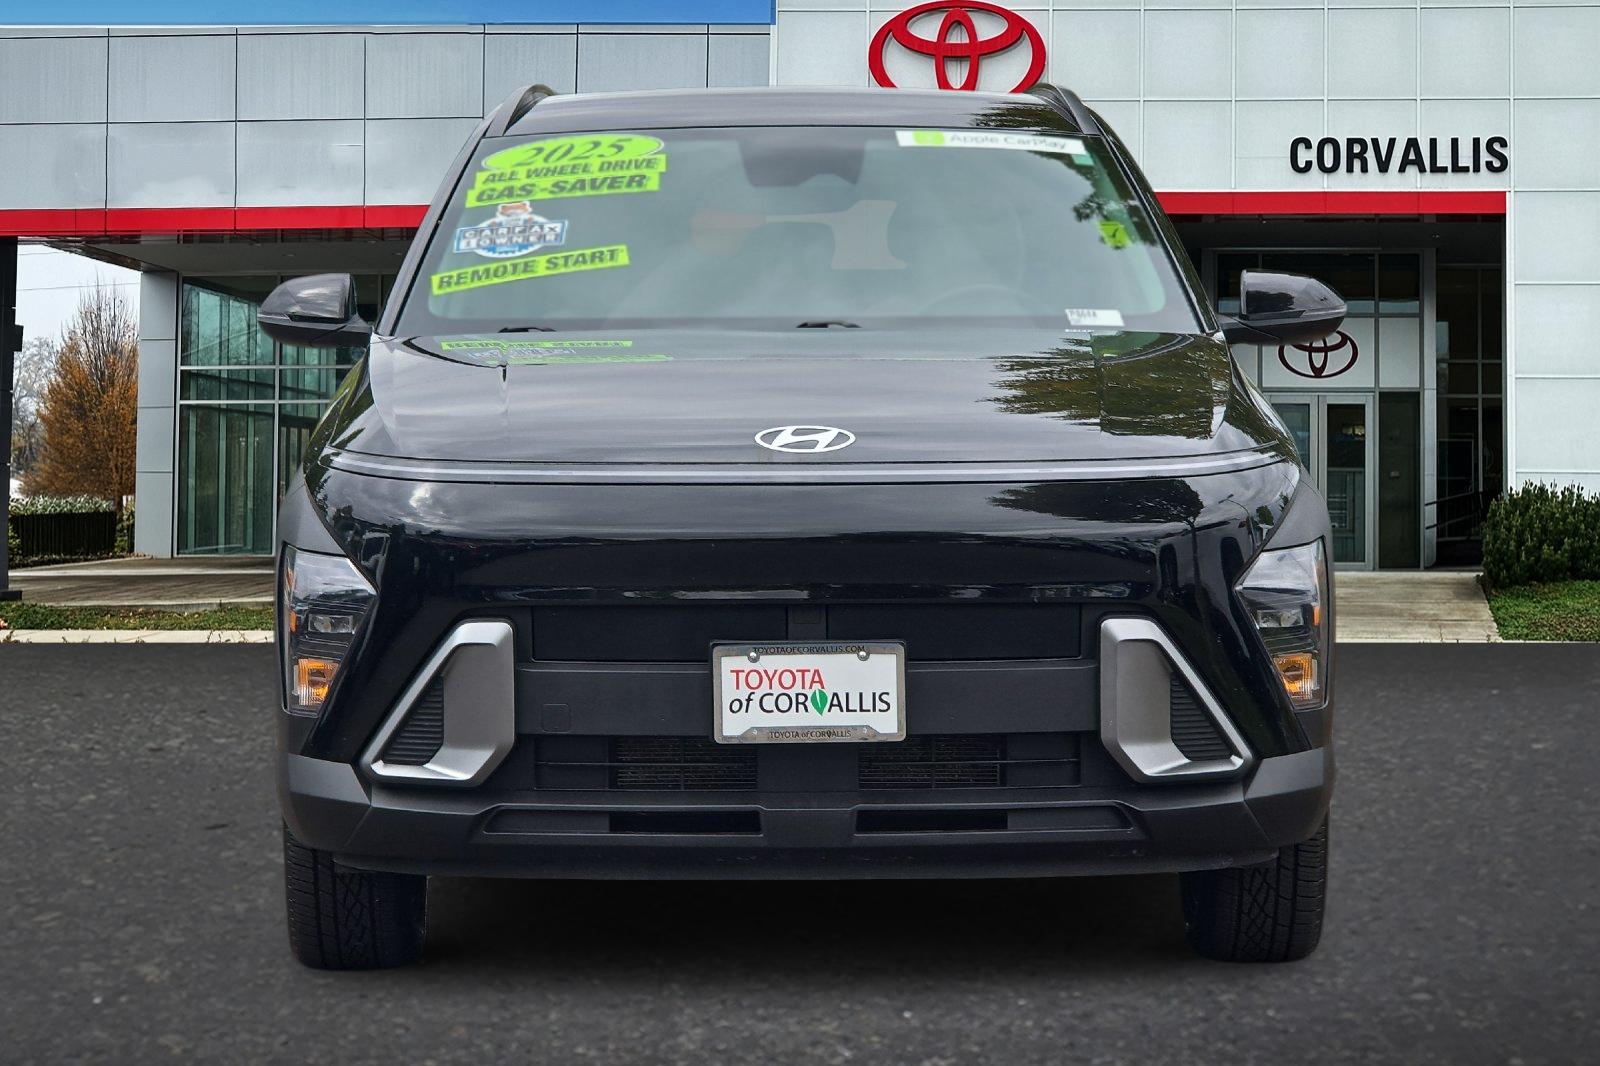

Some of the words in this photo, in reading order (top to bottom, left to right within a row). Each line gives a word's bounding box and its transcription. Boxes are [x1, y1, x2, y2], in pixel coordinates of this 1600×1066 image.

[513, 138, 633, 167] 2025
[950, 134, 999, 145] Apple
[1003, 136, 1067, 150] CarPlay
[1289, 136, 1509, 174] CORVALLIS
[482, 170, 521, 185] ALL
[525, 162, 593, 179] WHEEL
[596, 156, 659, 172] DRIVE
[476, 174, 648, 202] GAS-SAVER
[464, 224, 559, 239] CARFAX
[437, 259, 538, 291] REMOTE
[545, 247, 622, 271] START
[752, 644, 866, 654] TOYOTAOFCORVALLIS.COM
[730, 668, 825, 691] TOYOTA
[729, 691, 755, 714] of
[770, 730, 800, 739] TOYOTA
